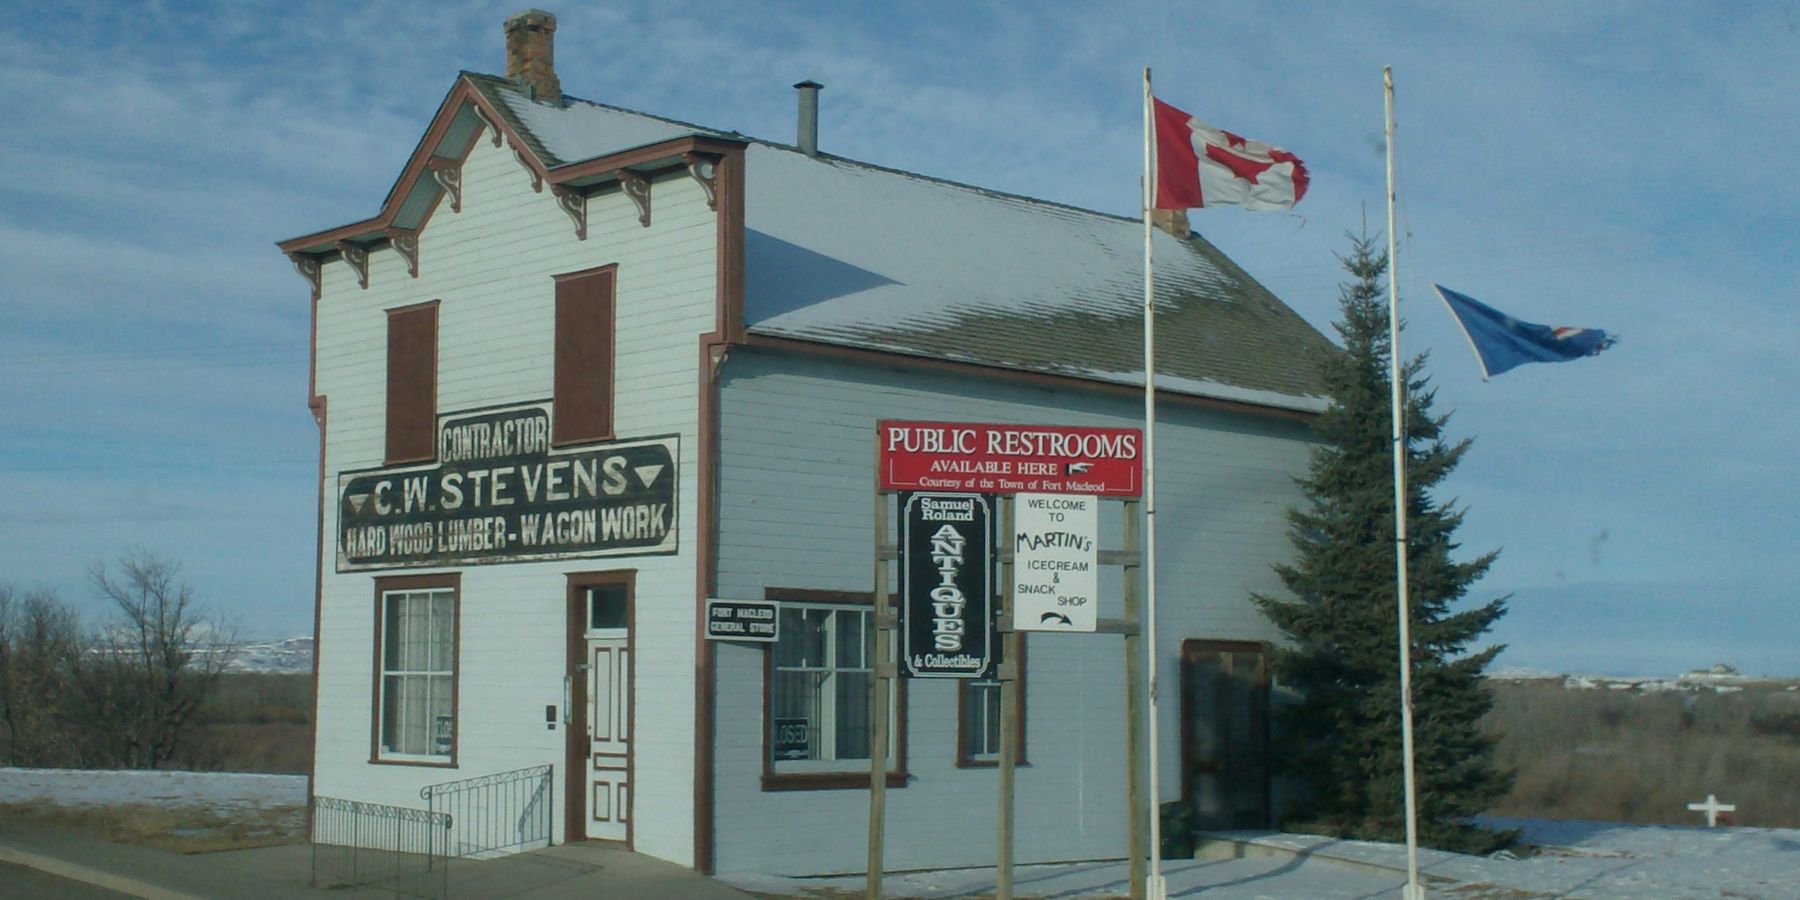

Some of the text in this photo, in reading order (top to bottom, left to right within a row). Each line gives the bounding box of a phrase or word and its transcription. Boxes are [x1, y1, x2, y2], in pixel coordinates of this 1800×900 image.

[442, 416, 548, 462] CONTRACTOR
[888, 427, 1137, 459] PUBLIC RESTROOMS
[930, 460, 1058, 476] AVAILABLE HERE
[374, 456, 628, 515] C.W. STEVENS
[919, 477, 1105, 492] Courtesy of the Town of Fort Macleod
[921, 498, 974, 510] Samuel
[1028, 499, 1086, 511] WELCOME
[921, 509, 974, 521] Roland
[1048, 512, 1064, 522] TO
[347, 525, 386, 558] HARD
[389, 522, 433, 556] WOOD
[438, 516, 507, 553] LUMBER
[521, 508, 596, 546] WAGON
[601, 504, 667, 540] WORK
[1027, 560, 1089, 572] ICECREAM
[1052, 572, 1060, 584] &
[930, 524, 966, 652] ANTIQUES
[1018, 584, 1056, 595] SNACK
[1057, 595, 1087, 607] SHOP
[712, 607, 733, 618] FORT
[711, 621, 775, 634] GENERAL STORE
[914, 654, 981, 668] & Collectibles
[775, 724, 808, 743] LOSED
